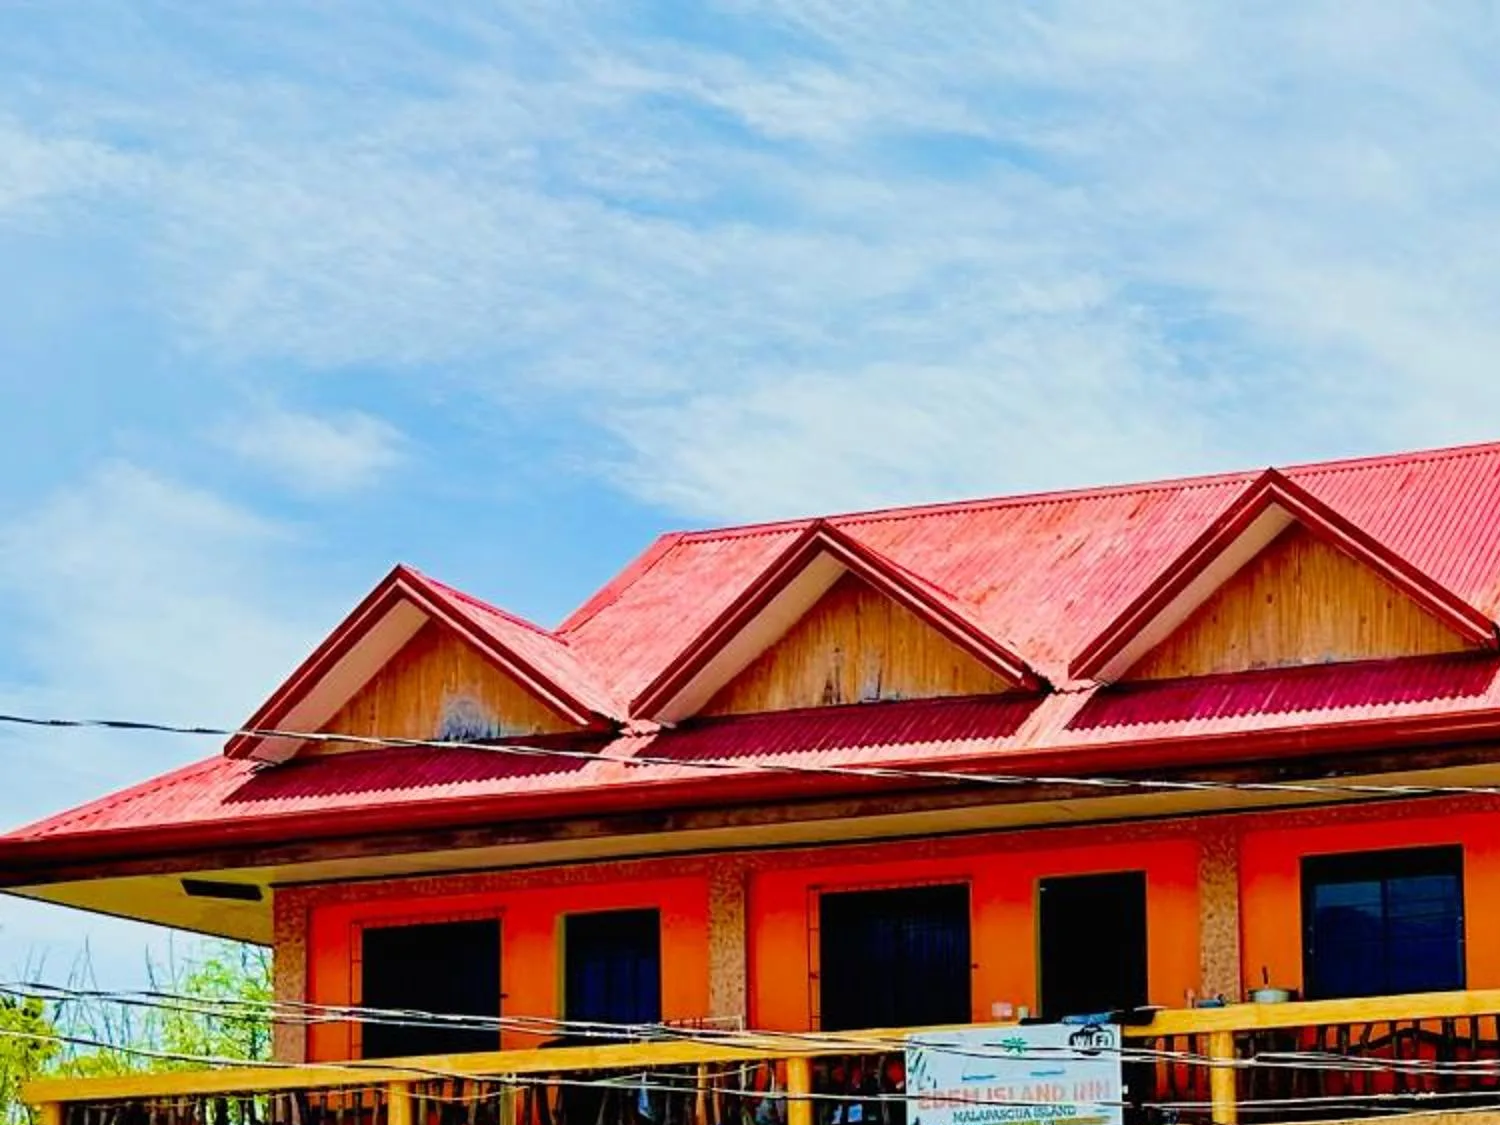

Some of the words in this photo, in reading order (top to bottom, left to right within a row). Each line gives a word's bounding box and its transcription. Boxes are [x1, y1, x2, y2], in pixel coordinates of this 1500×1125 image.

[986, 1083, 1066, 1104] ISLAND
[1072, 1079, 1111, 1101] INN
[1033, 1104, 1077, 1118] ISLAND
